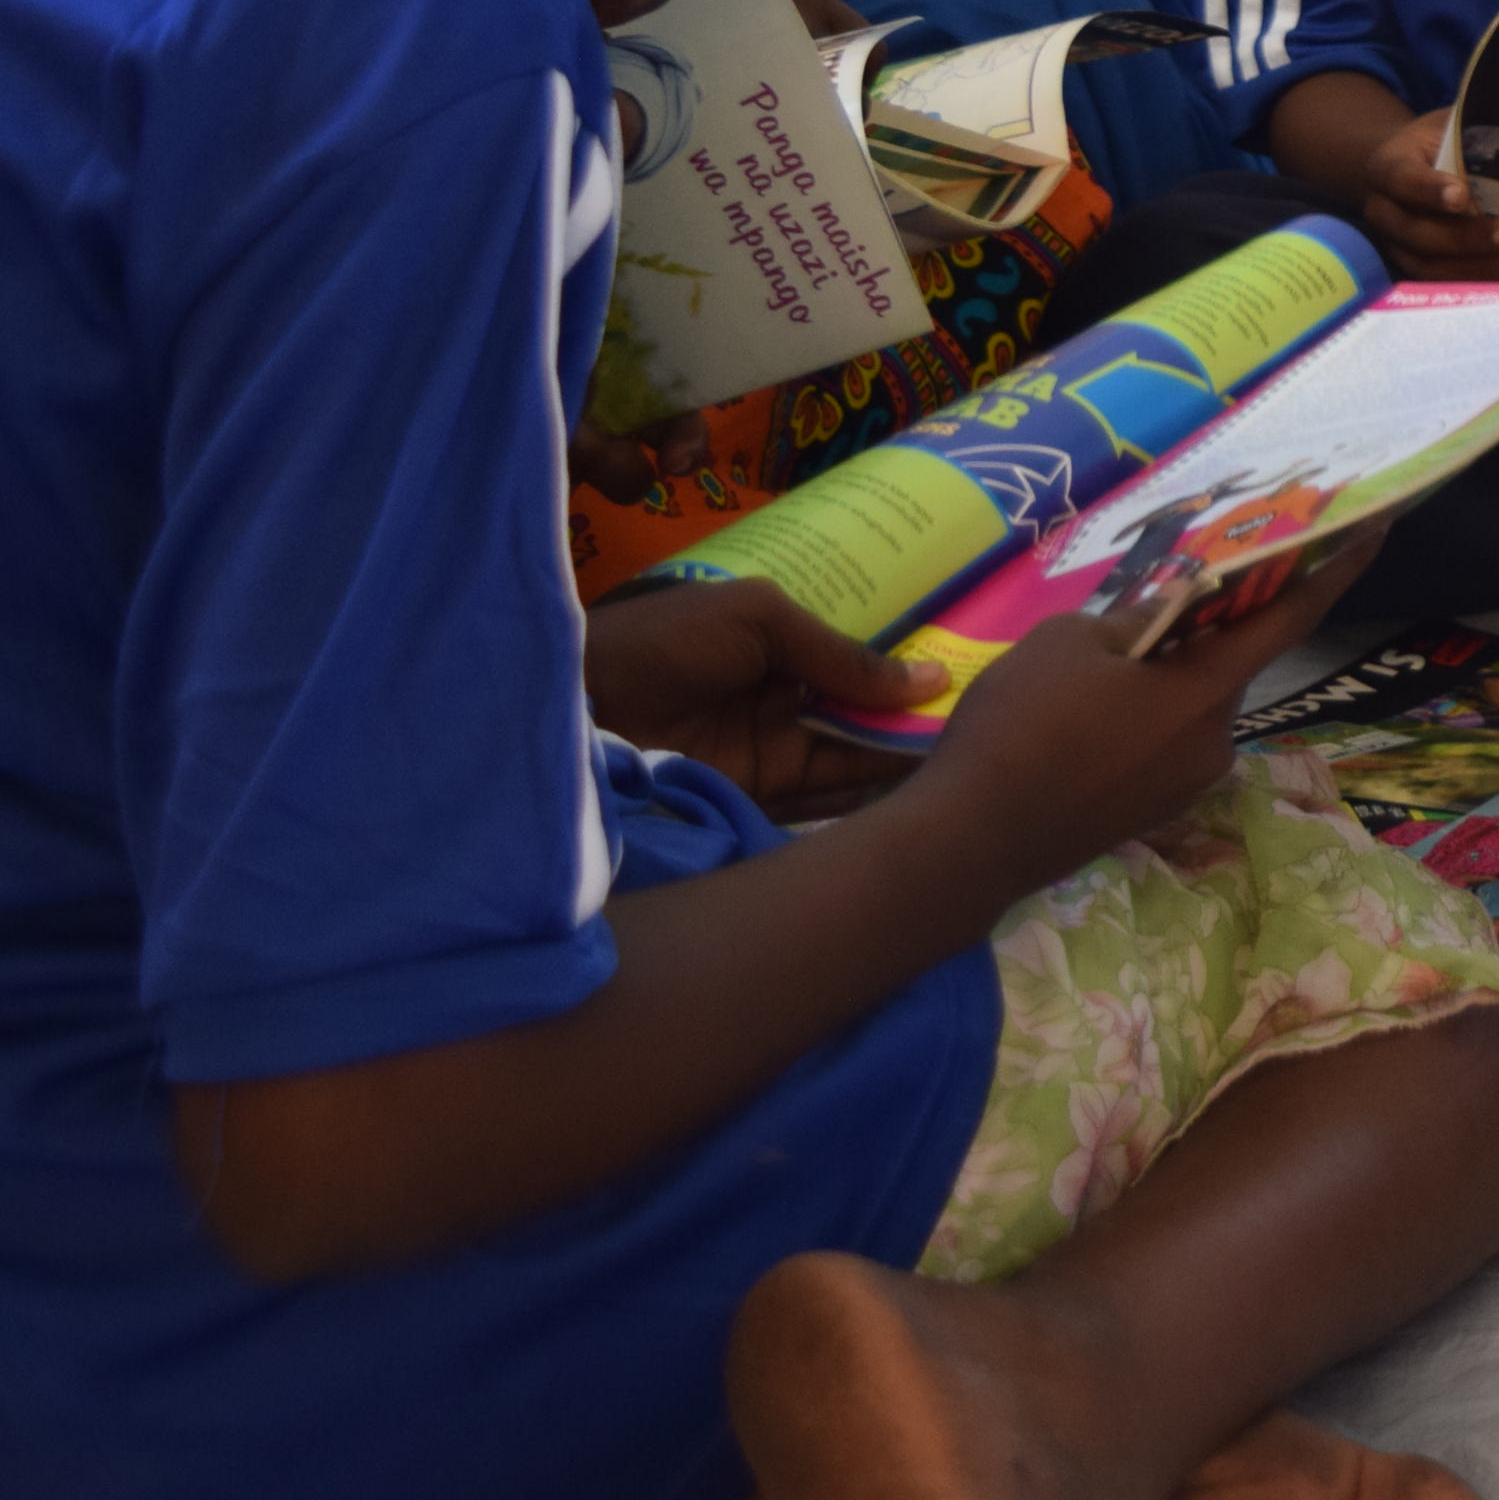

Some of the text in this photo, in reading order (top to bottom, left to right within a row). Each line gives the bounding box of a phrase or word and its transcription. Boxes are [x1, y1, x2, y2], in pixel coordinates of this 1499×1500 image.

[689, 148, 813, 324] wa mpango
[737, 154, 838, 291] na uzazi
[740, 81, 892, 317] Panga maisha
[1360, 649, 1426, 677] SI
